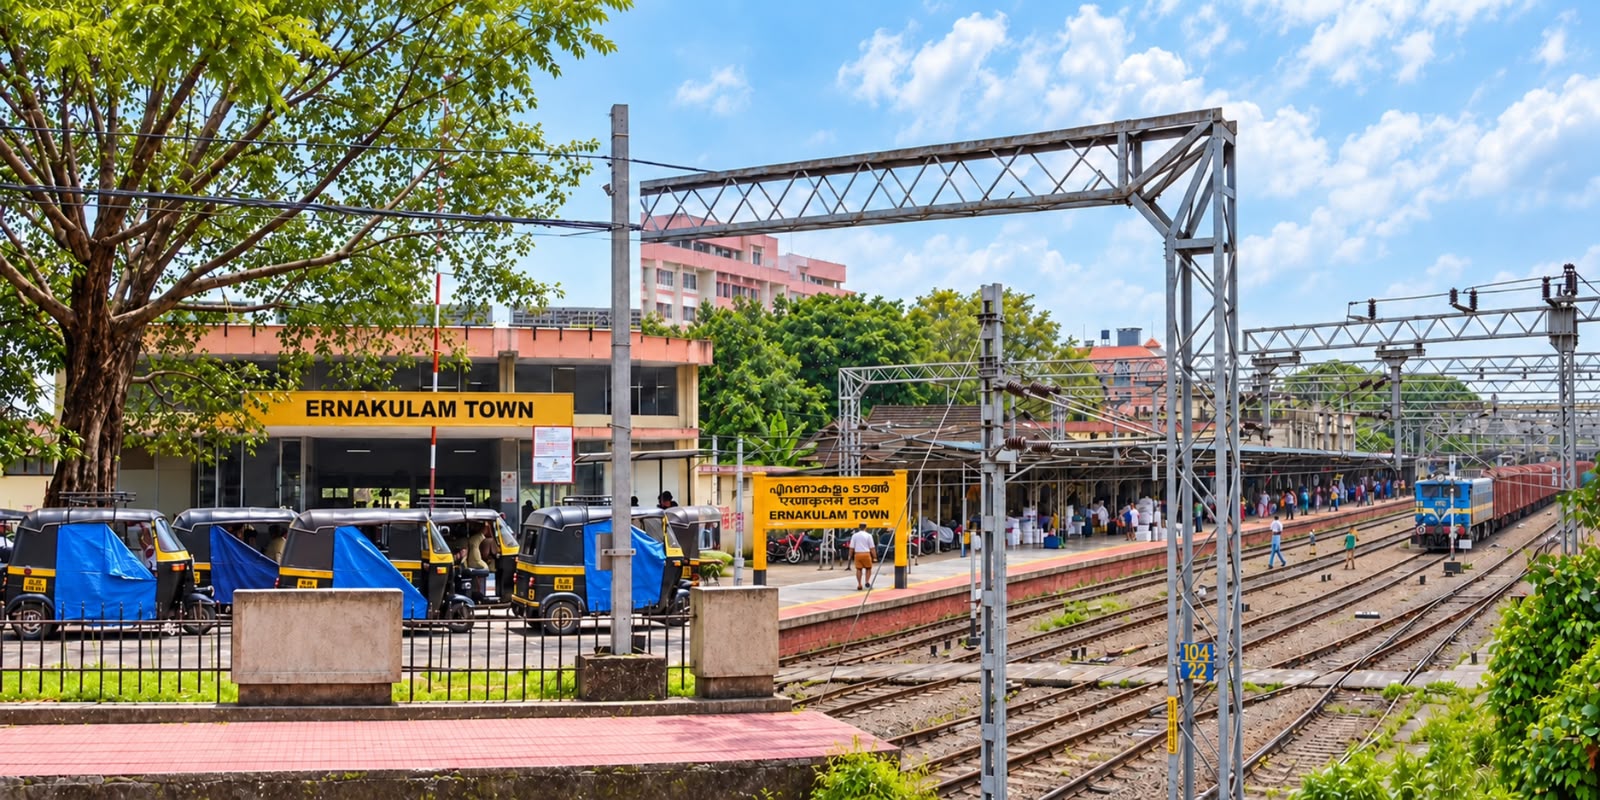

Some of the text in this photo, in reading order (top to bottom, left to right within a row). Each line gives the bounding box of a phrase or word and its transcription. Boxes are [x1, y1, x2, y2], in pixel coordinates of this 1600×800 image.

[306, 399, 534, 419] ERNAKULAM TOWN
[848, 496, 880, 505] टाउन
[769, 510, 890, 520] ERNAKULAM TOWN
[1183, 643, 1210, 662] 104
[1188, 662, 1207, 679] 22
